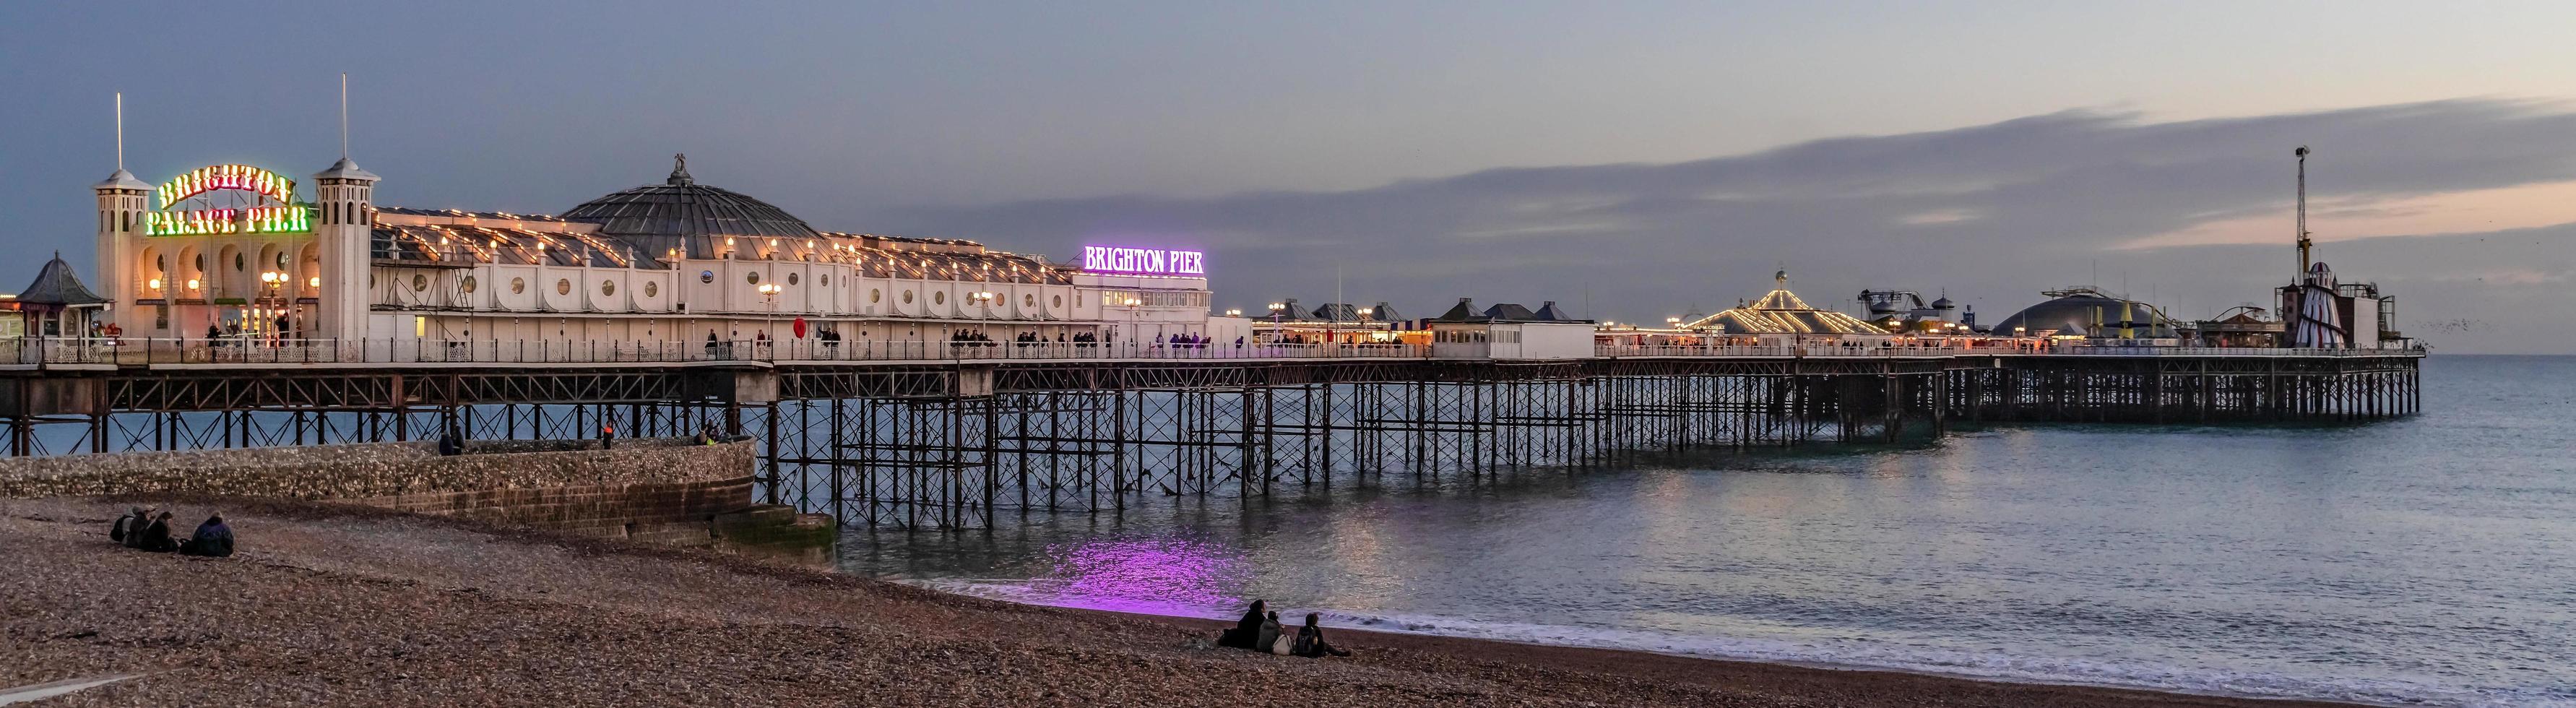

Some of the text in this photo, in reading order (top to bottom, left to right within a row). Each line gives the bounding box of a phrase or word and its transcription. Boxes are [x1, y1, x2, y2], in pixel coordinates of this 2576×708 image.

[157, 165, 295, 210] BRIGHTON
[146, 207, 310, 236] PALACE PIER
[1084, 246, 1204, 274] BRIGHTON PIER
